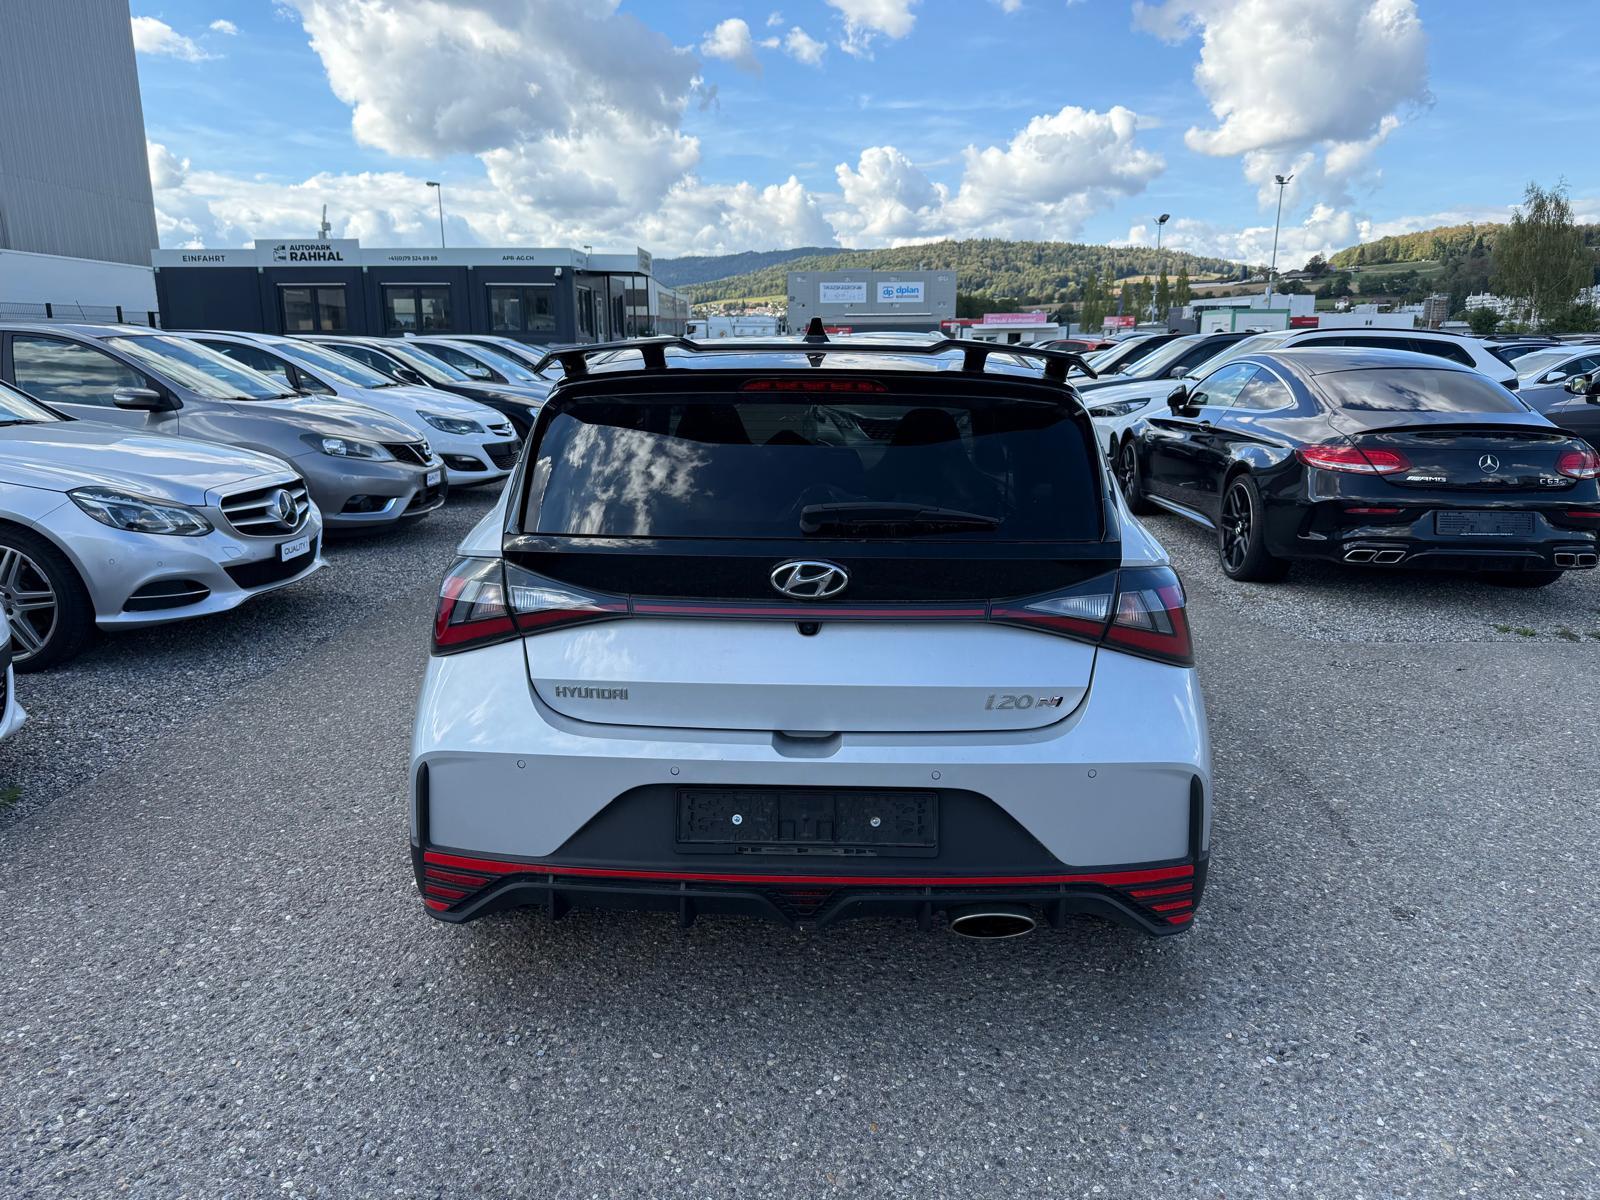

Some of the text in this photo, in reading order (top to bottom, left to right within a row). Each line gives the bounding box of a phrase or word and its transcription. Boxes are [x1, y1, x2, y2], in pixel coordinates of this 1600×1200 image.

[289, 251, 344, 262] RAHHAL
[896, 286, 919, 295] dplan
[555, 685, 629, 700] HYUNDAI
